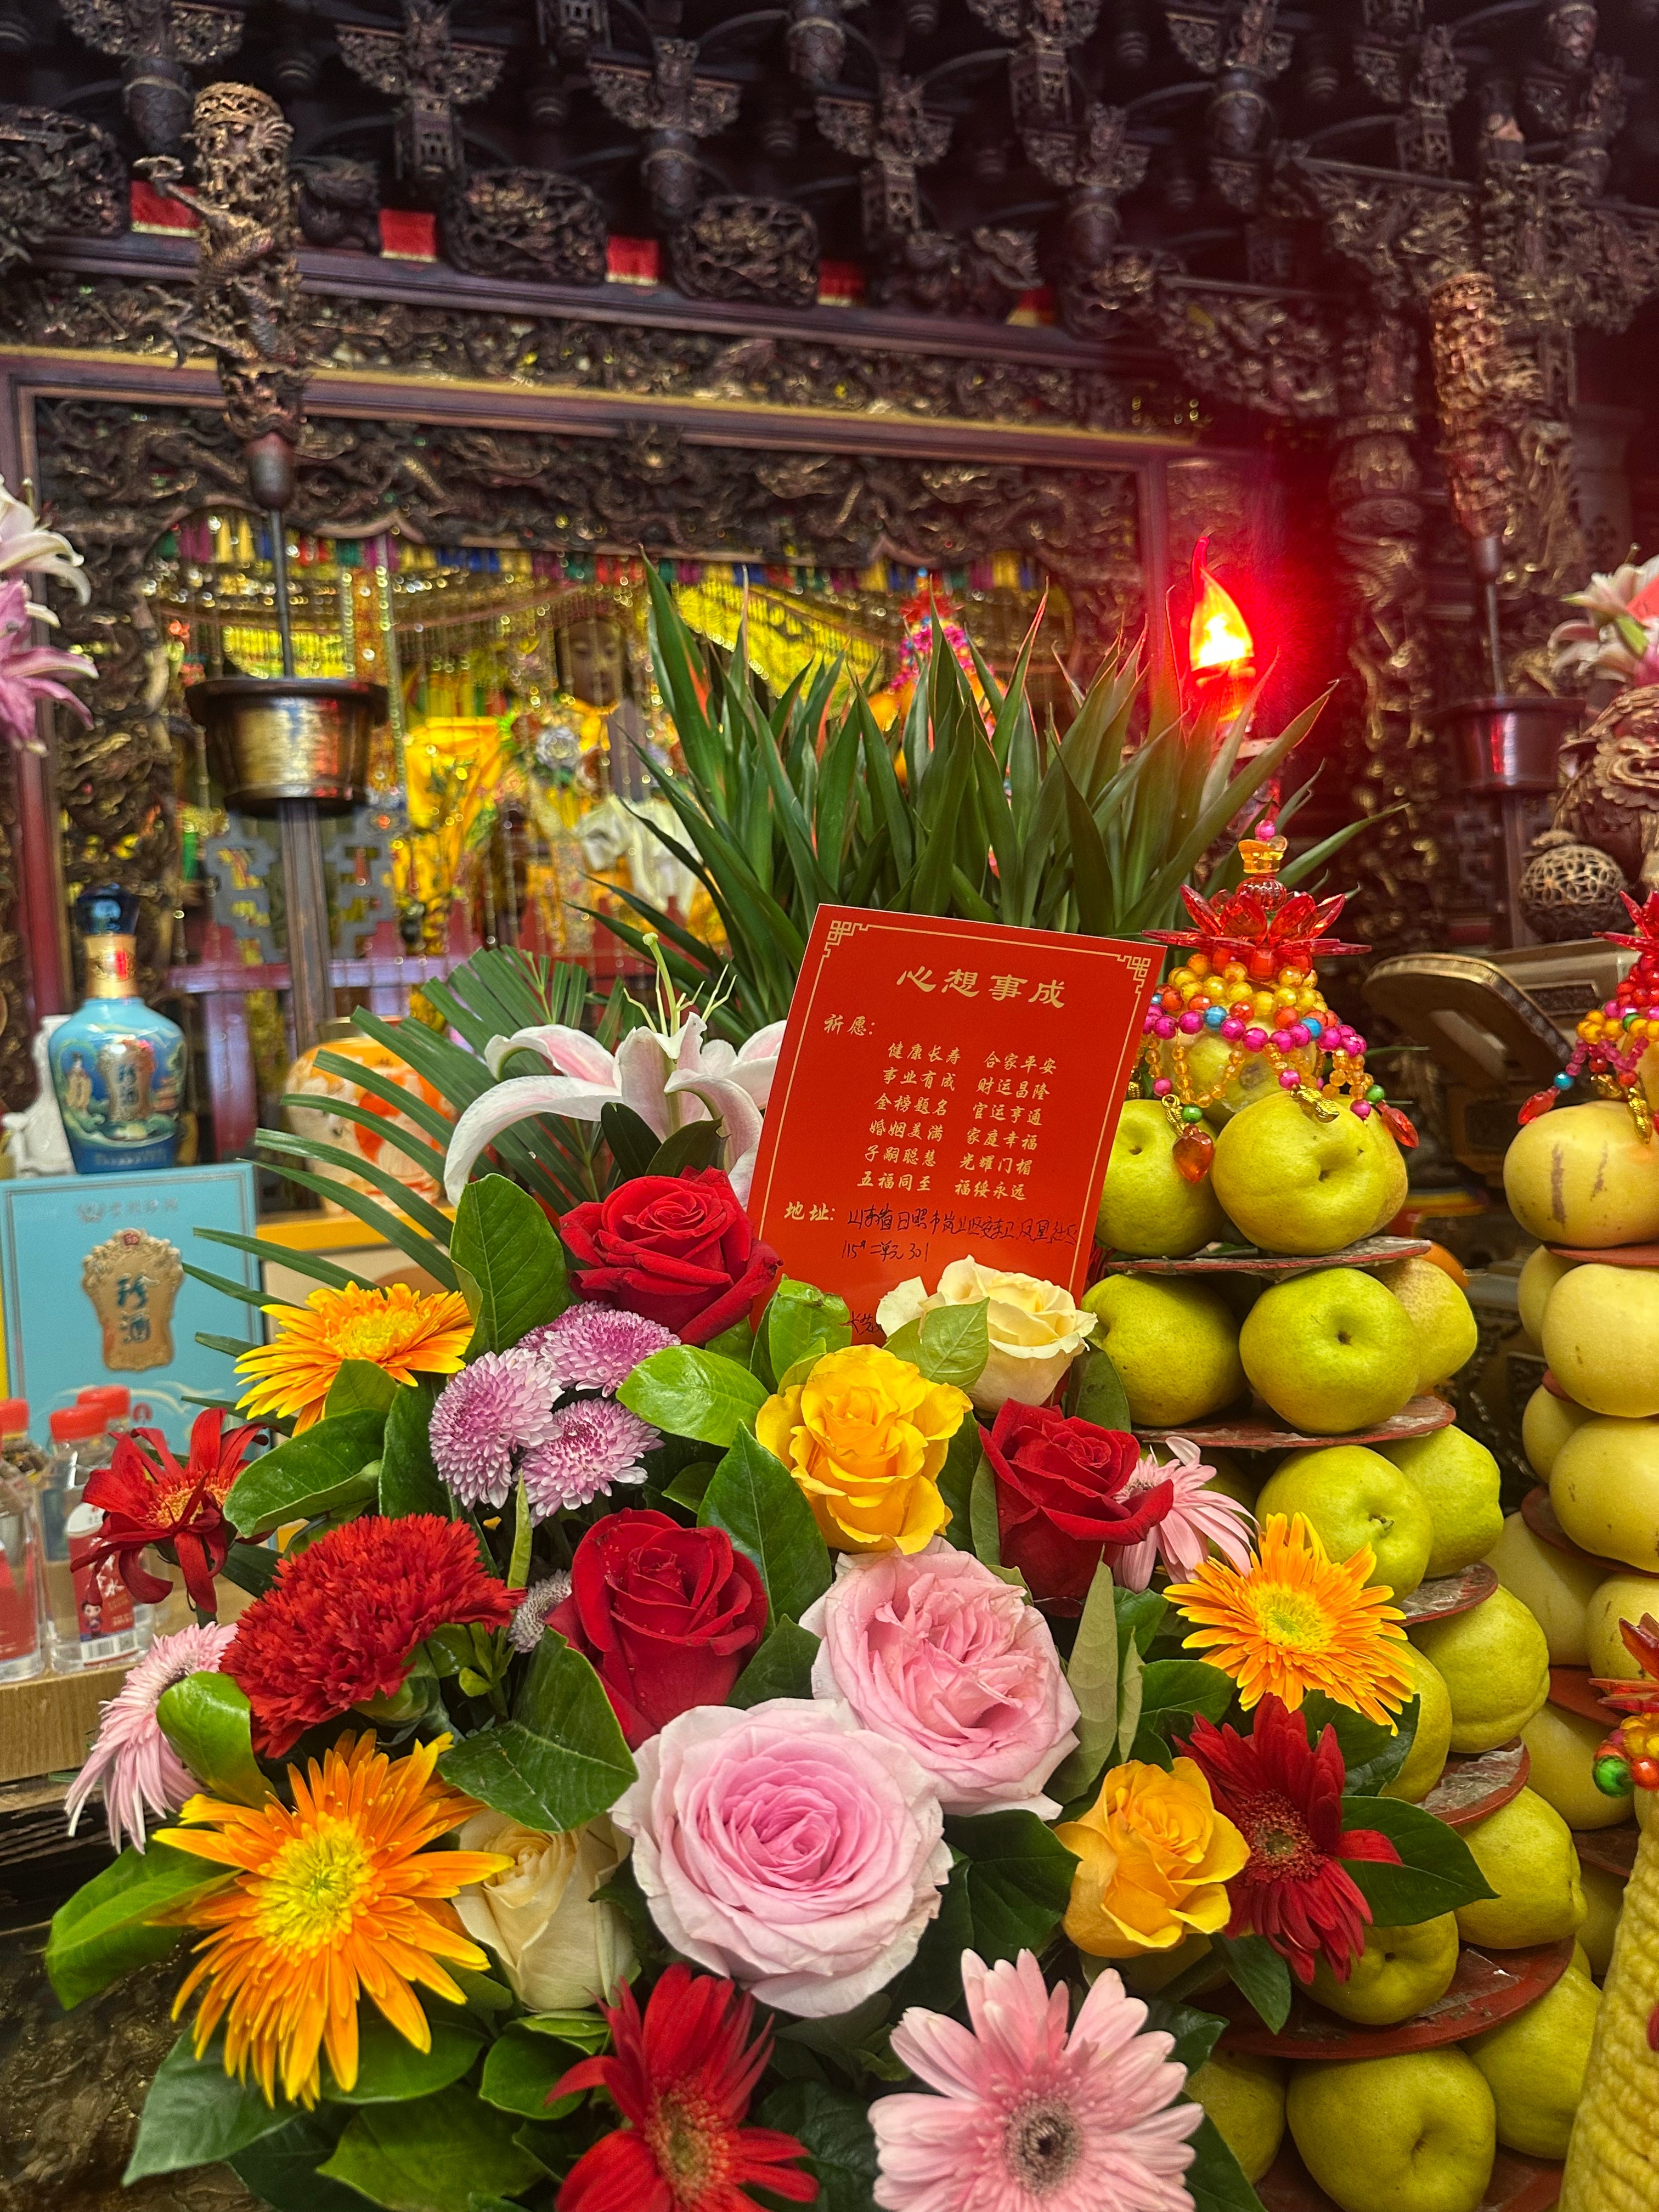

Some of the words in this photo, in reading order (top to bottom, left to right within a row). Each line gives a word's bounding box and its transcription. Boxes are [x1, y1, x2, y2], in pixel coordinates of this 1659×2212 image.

[896, 966, 1065, 1008] 心想事成
[823, 1013, 876, 1036] 祈愿：
[888, 1040, 961, 1065] 健康长寿
[983, 1050, 1057, 1075] 合家平安
[882, 1066, 956, 1092] 事业有成
[975, 1076, 1051, 1101] 财运昌隆
[873, 1092, 948, 1116] 金榜题名
[972, 1101, 1042, 1126] 官运亨通
[869, 1119, 944, 1143] 婚姻美满
[966, 1126, 1037, 1150] 家庭幸福
[865, 1144, 936, 1167] 子嗣聪慧
[959, 1153, 1032, 1176] 光耀门楣
[856, 1170, 931, 1192] 五福同至
[955, 1178, 1026, 1200] 福绥永远
[783, 1201, 835, 1222] 地址：
